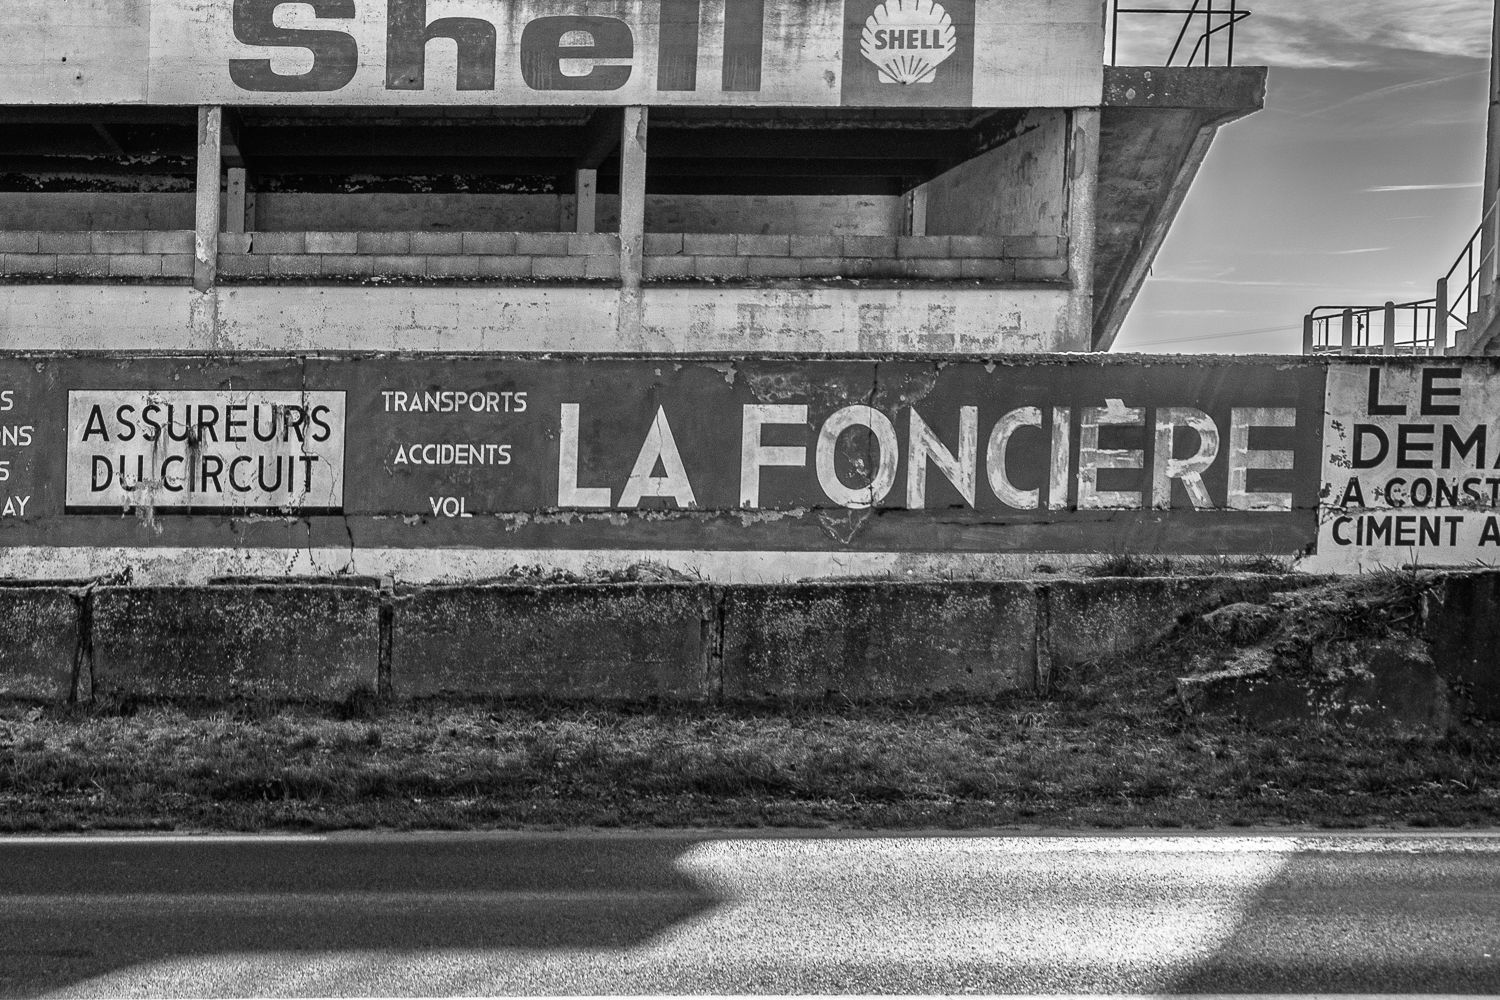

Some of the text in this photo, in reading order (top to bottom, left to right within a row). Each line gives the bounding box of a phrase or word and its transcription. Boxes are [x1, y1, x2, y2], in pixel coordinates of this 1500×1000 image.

[875, 29, 944, 50] SHELL
[381, 391, 527, 412] TRANSPORTS
[1367, 368, 1462, 415] LE
[82, 404, 331, 442] ASSUREURS
[394, 444, 511, 464] ACCIDENTS
[558, 398, 1297, 512] LA FONCIÈRE
[1352, 424, 1500, 469] DEM
[91, 455, 319, 492] DU CIRCUIT
[429, 496, 473, 517] VOL
[1340, 477, 1365, 507] A
[1332, 516, 1464, 546] CIMENT
